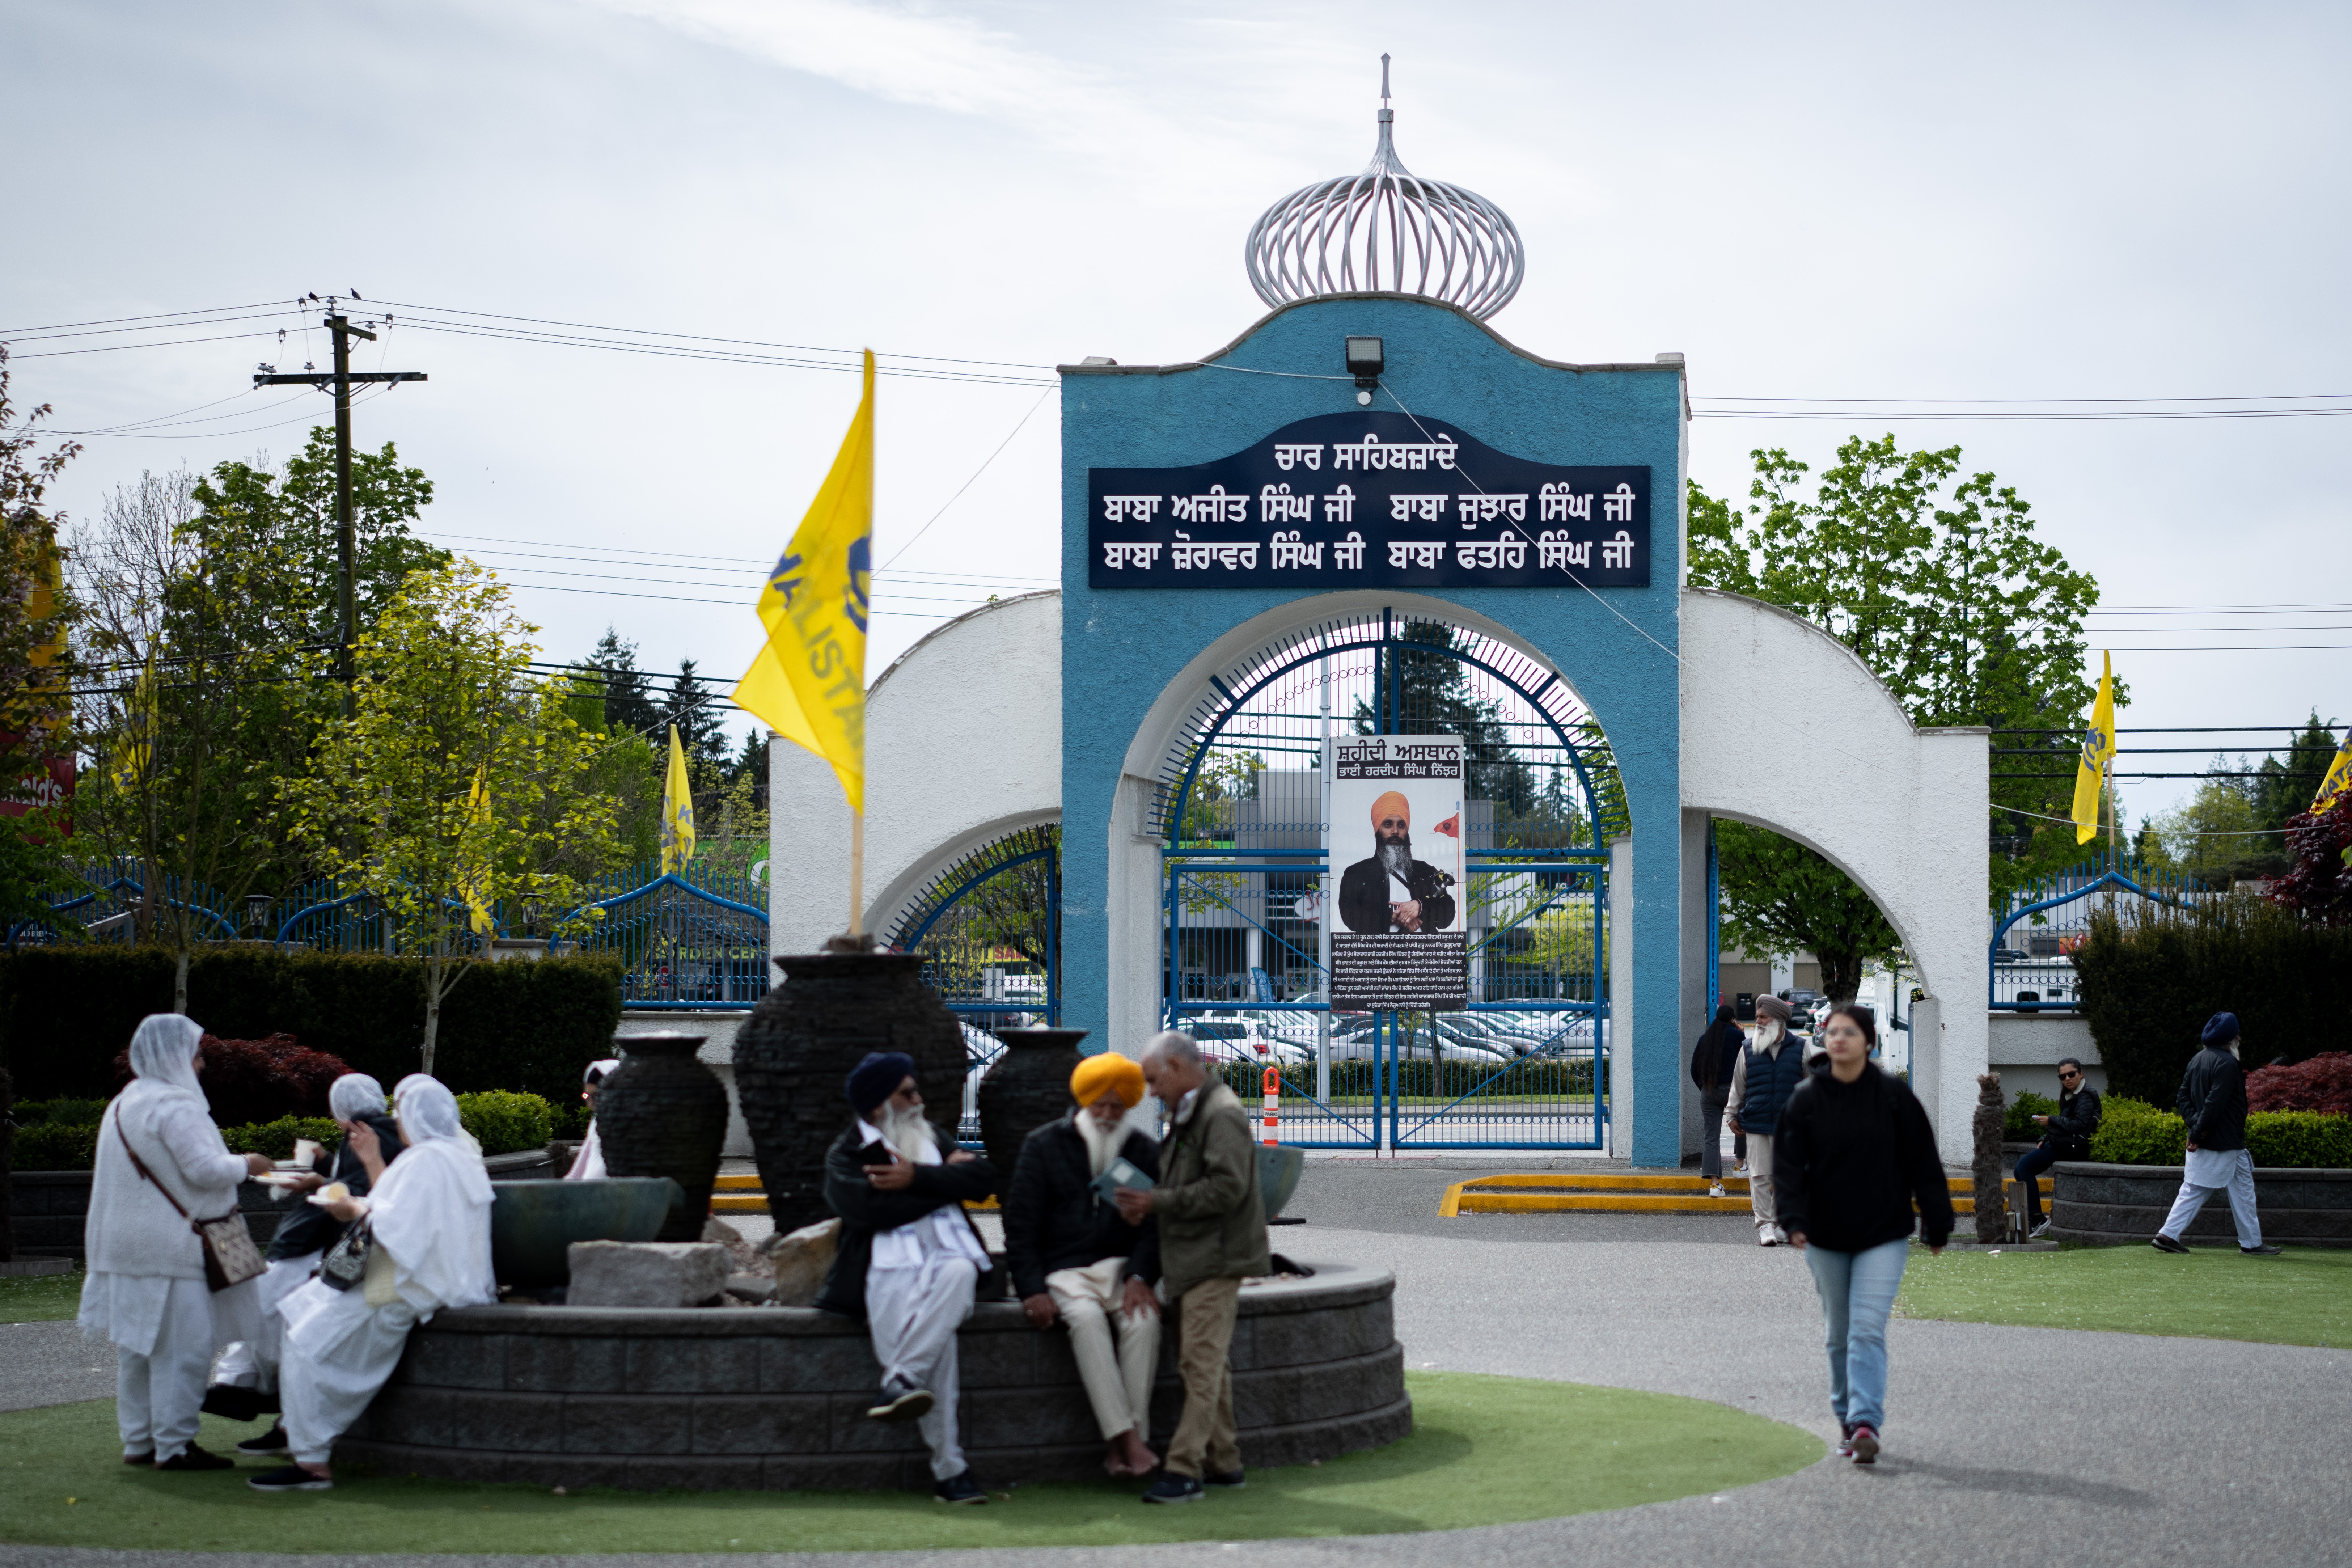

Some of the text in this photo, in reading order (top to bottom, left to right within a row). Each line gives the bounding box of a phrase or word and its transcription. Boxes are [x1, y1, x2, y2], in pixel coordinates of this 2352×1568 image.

[1275, 433, 1458, 470] ਚਾਰ ਸਾਹਿਬਜ਼ਾਦੇ
[1104, 483, 1355, 522] ਬਾਬਾ ਅਜੀਤ ਸਿੰਘ ਜੀ
[1390, 482, 1635, 530] ਬਾਬਾ ਜੁਝਾਰ ਸਿੰਘ ਜੀ
[1104, 530, 1366, 570] ਬਾਬਾ ਜ਼ੋਰਾਵਰ ਸਿੰਘ ਜੀ
[1388, 529, 1634, 569] ਬਾਬਾ ਫਤਹਿ ਸਿੰਘ ਜੀ
[1337, 739, 1460, 761] ਸ਼ਹੀਦੀ ਅਸਥਾਨ
[1339, 763, 1458, 777] ਭਾਈ ਹਰਦੀਪ ਸਿੰਘ ਨਿੱਝਰ
